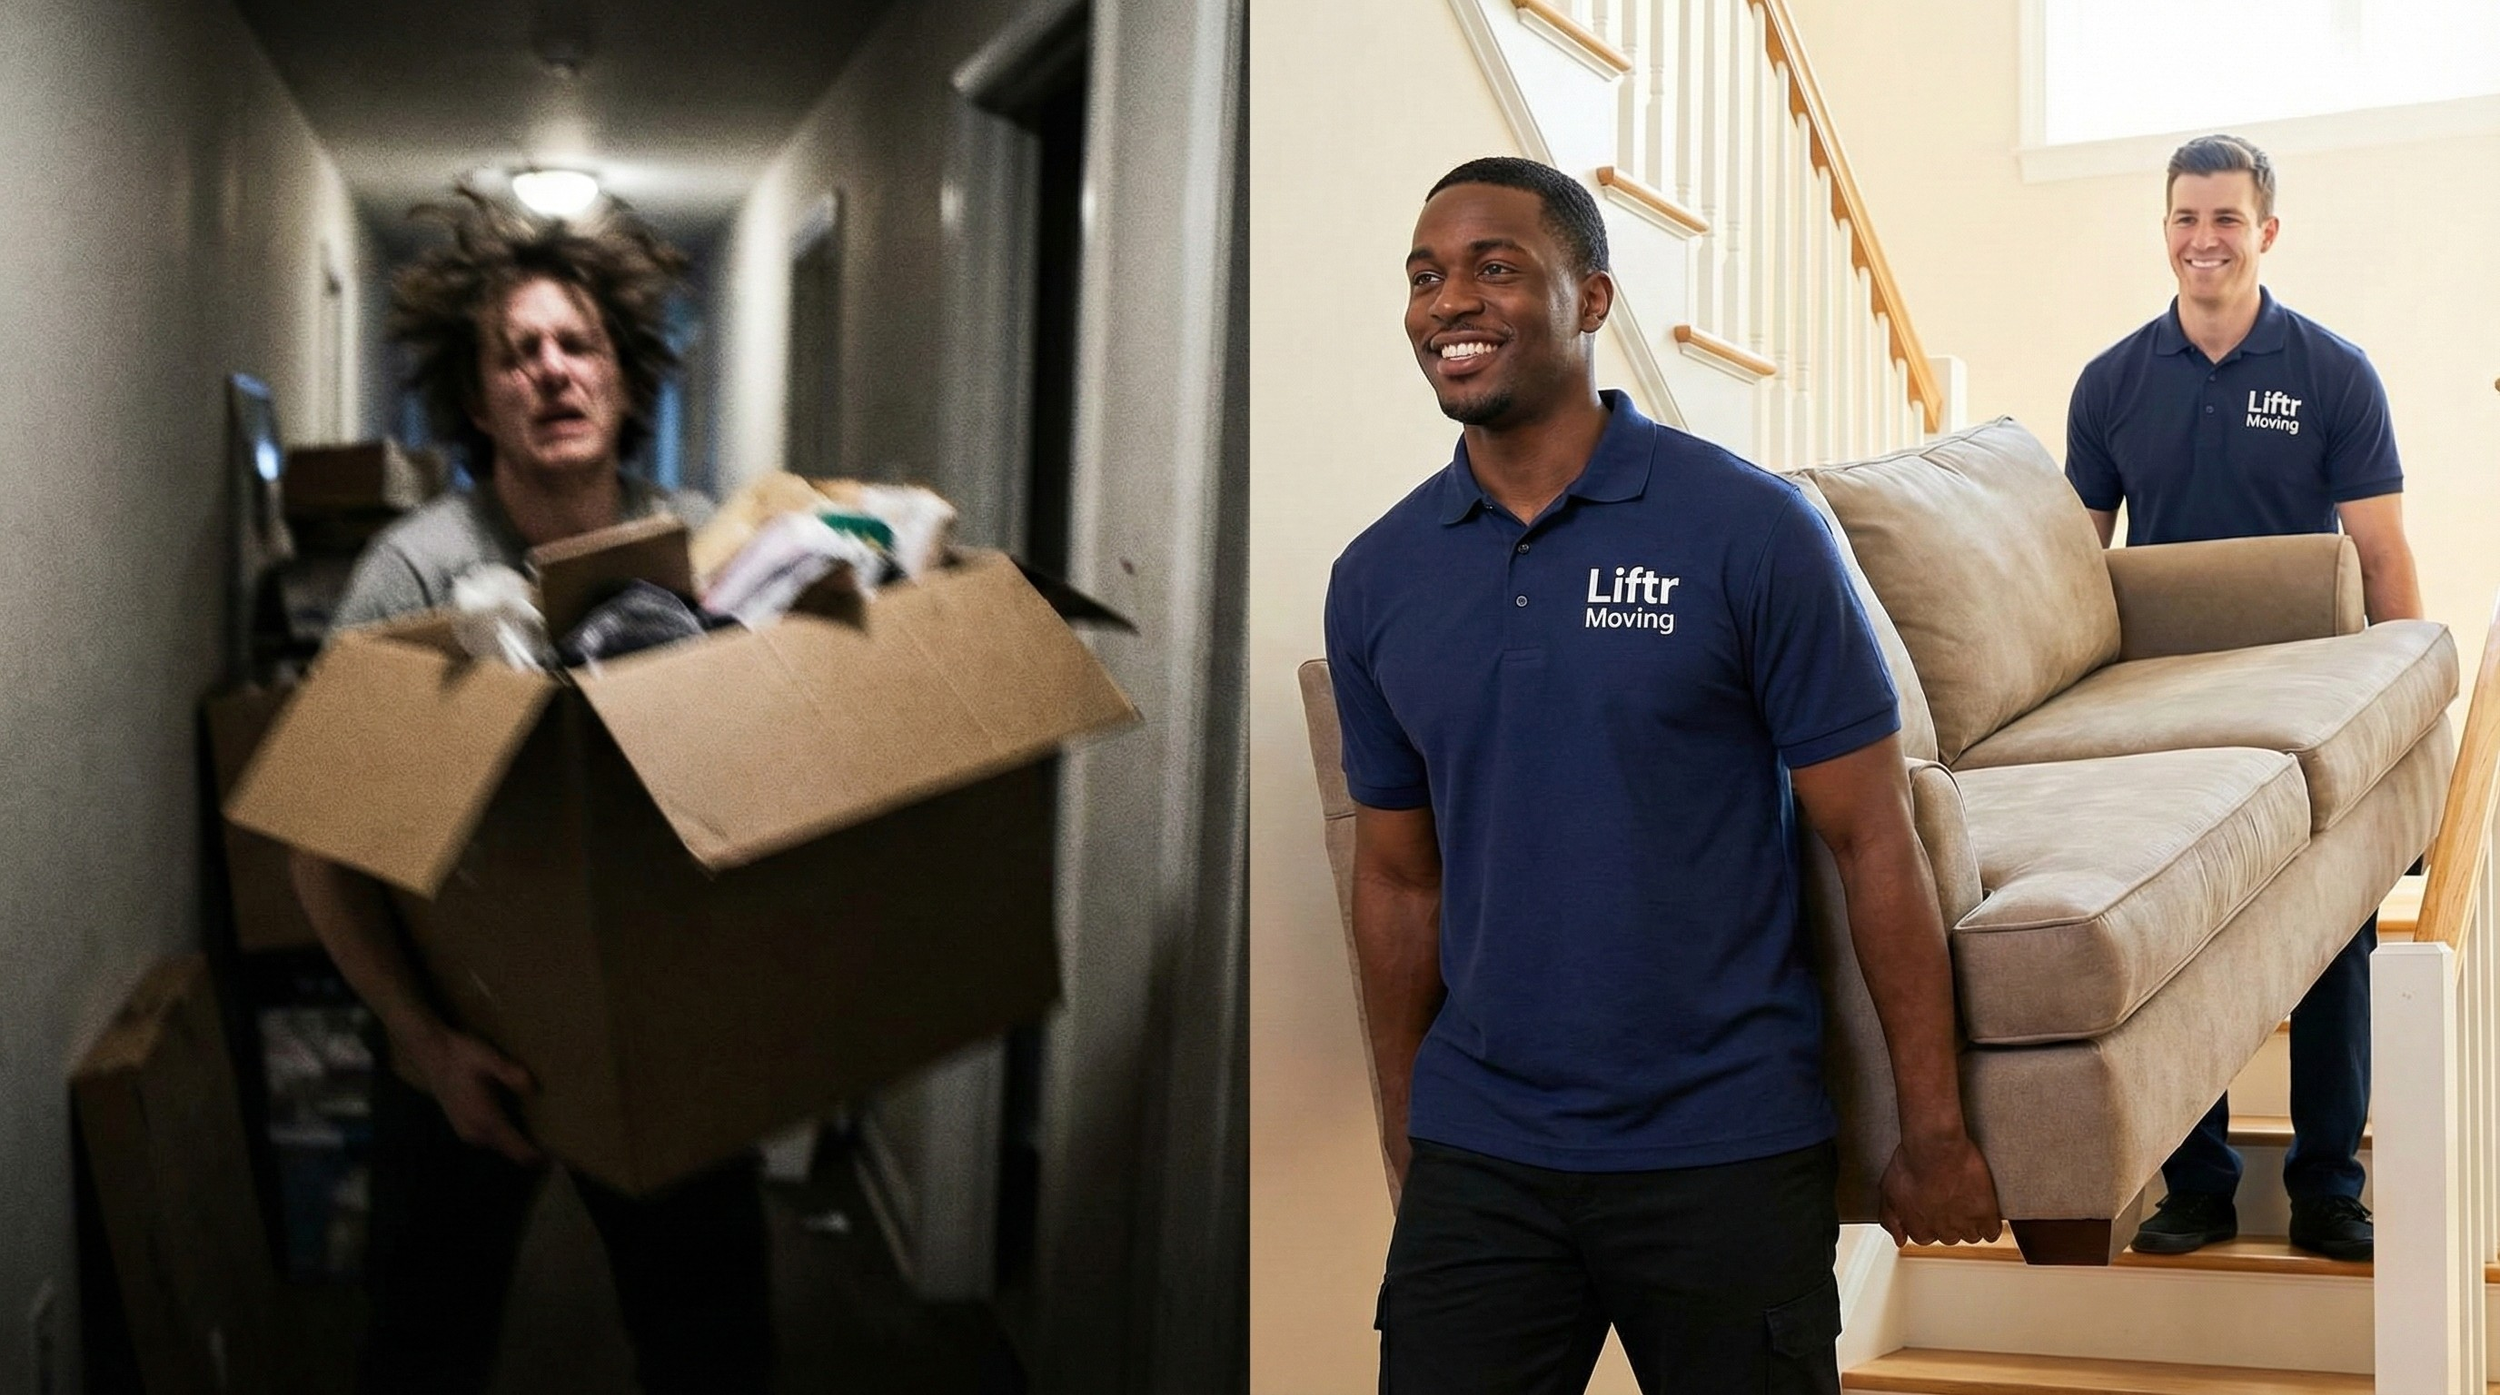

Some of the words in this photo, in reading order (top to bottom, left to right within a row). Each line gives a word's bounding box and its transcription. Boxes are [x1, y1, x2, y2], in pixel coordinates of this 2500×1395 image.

[2247, 390, 2302, 417] Liftr
[2246, 413, 2299, 435] Moving
[1587, 566, 1680, 604] Liftr
[1585, 606, 1675, 635] Moving
